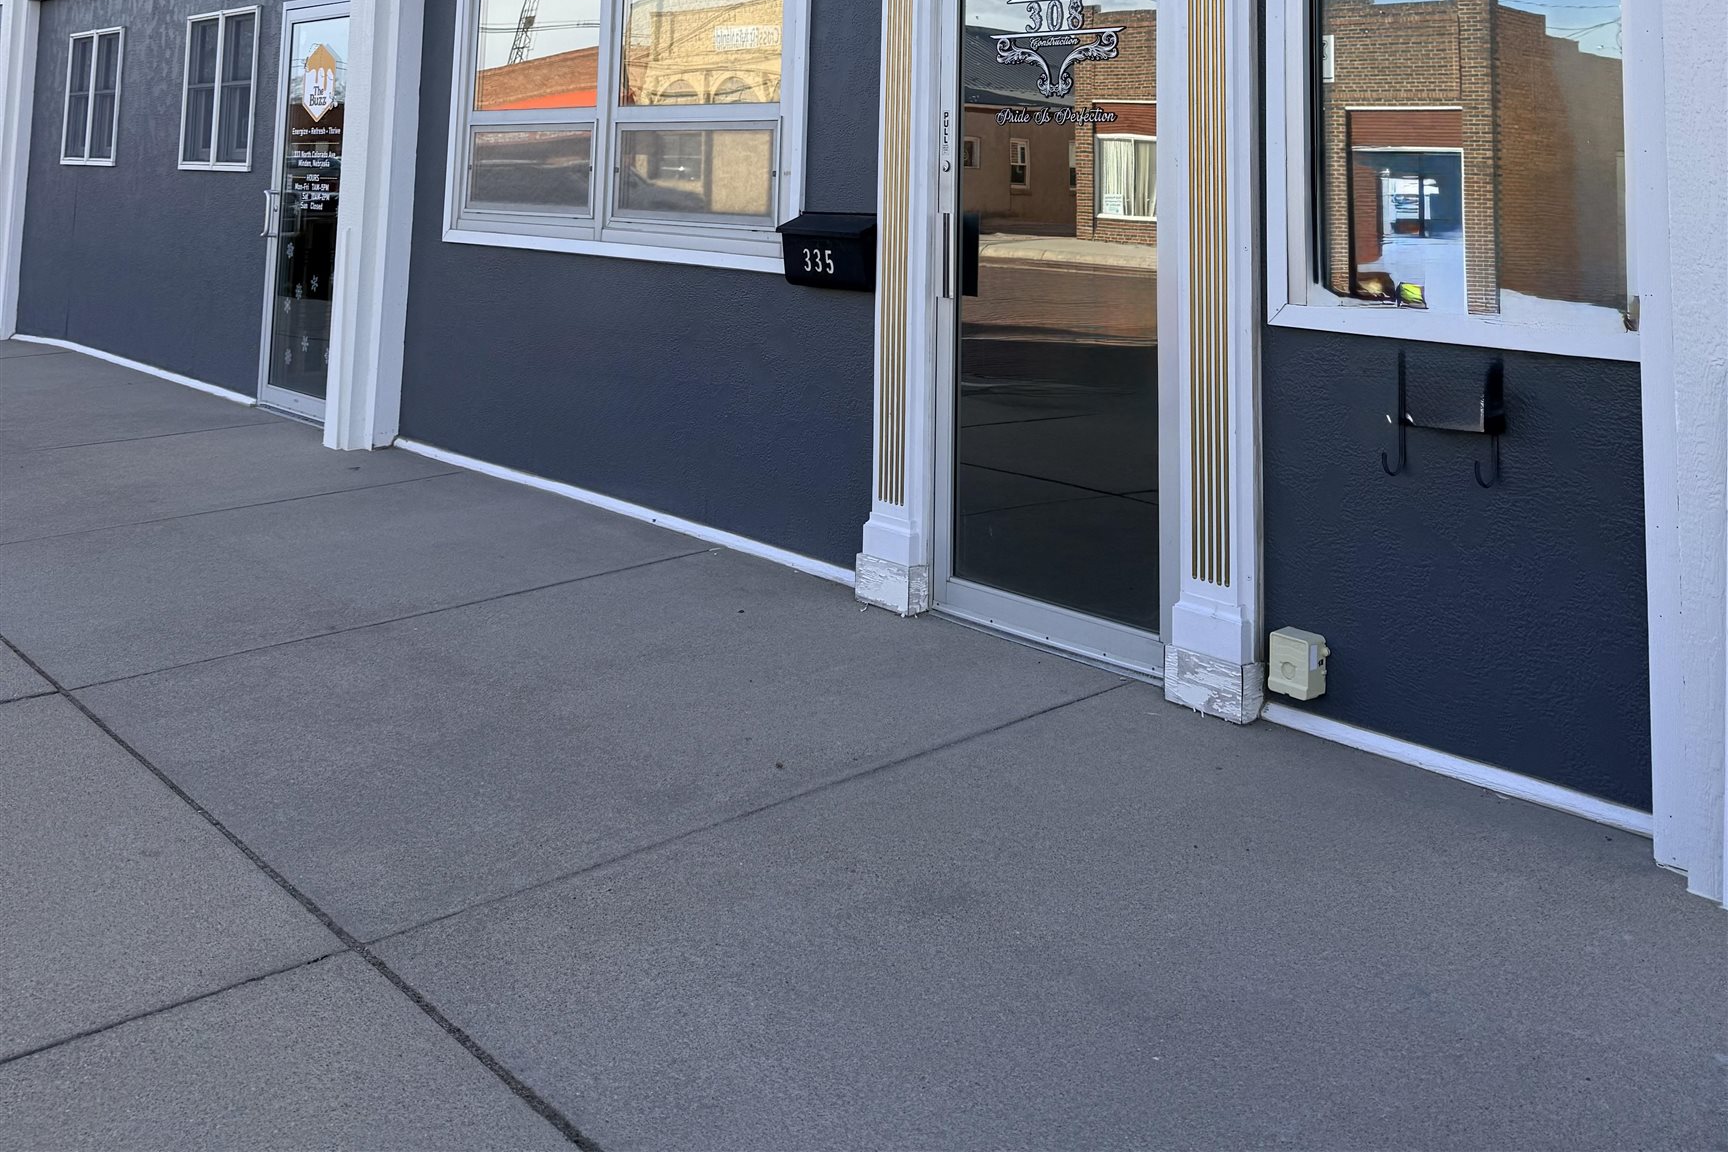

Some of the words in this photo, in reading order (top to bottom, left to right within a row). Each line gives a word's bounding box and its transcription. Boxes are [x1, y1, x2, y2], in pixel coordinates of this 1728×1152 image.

[1030, 35, 1080, 49] Construction
[313, 86, 324, 96] The
[309, 94, 327, 106] Buzz
[995, 107, 1031, 126] Pride
[1033, 107, 1051, 125] Is
[1054, 107, 1119, 125] Perfection
[306, 174, 320, 182] HOURS
[802, 248, 835, 274] 335
